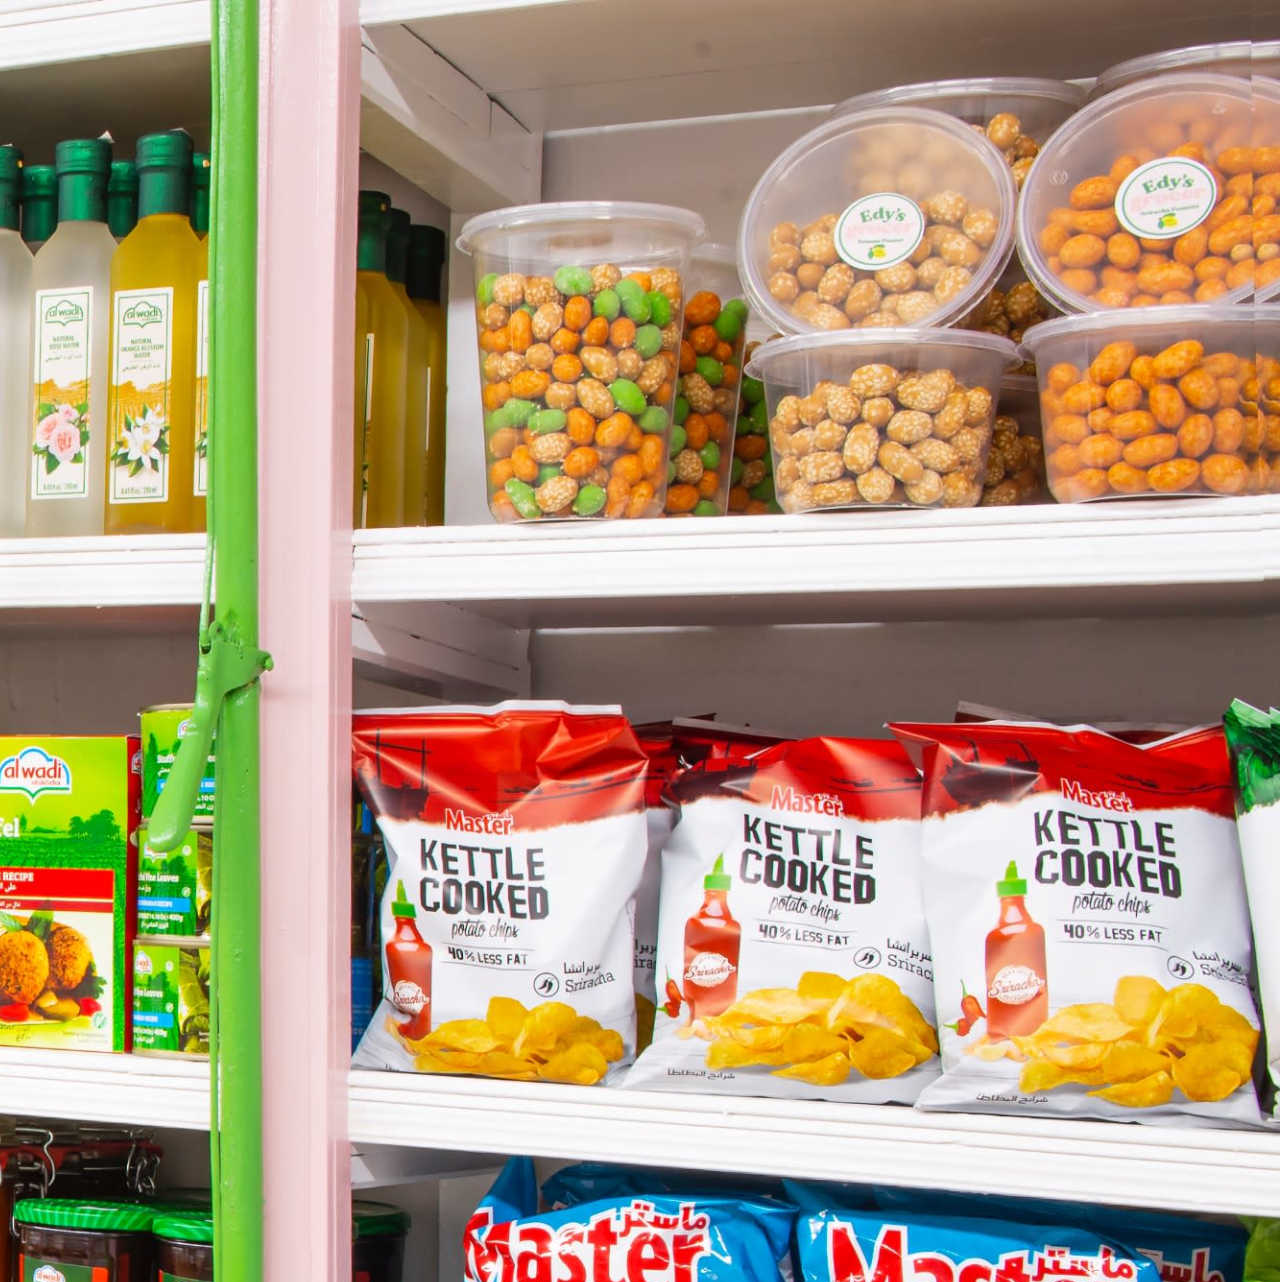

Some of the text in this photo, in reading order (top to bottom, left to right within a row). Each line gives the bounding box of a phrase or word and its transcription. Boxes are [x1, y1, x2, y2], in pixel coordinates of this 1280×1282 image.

[1142, 172, 1195, 194] Edy's
[859, 205, 908, 225] Edy's
[22, 758, 61, 779] wadi
[771, 785, 843, 817] Master
[1060, 778, 1133, 813] Master
[445, 809, 512, 835] Master
[1034, 809, 1176, 858] KETTLE
[744, 814, 874, 869] KETTLE
[420, 839, 545, 881] KETTLE
[2, 872, 34, 882] RECIPE
[740, 848, 876, 904] COOKED
[1035, 849, 1182, 899] COOKED
[420, 877, 549, 920] COOKED
[769, 895, 841, 922] potato chips
[1072, 892, 1151, 917] potato chips
[452, 918, 520, 942] potato chips
[758, 924, 850, 945] 40% LESS FAT
[1064, 924, 1163, 943] 40% LESS FAT
[447, 946, 529, 965] 40% LESS FAT
[565, 971, 615, 993] Sriracha
